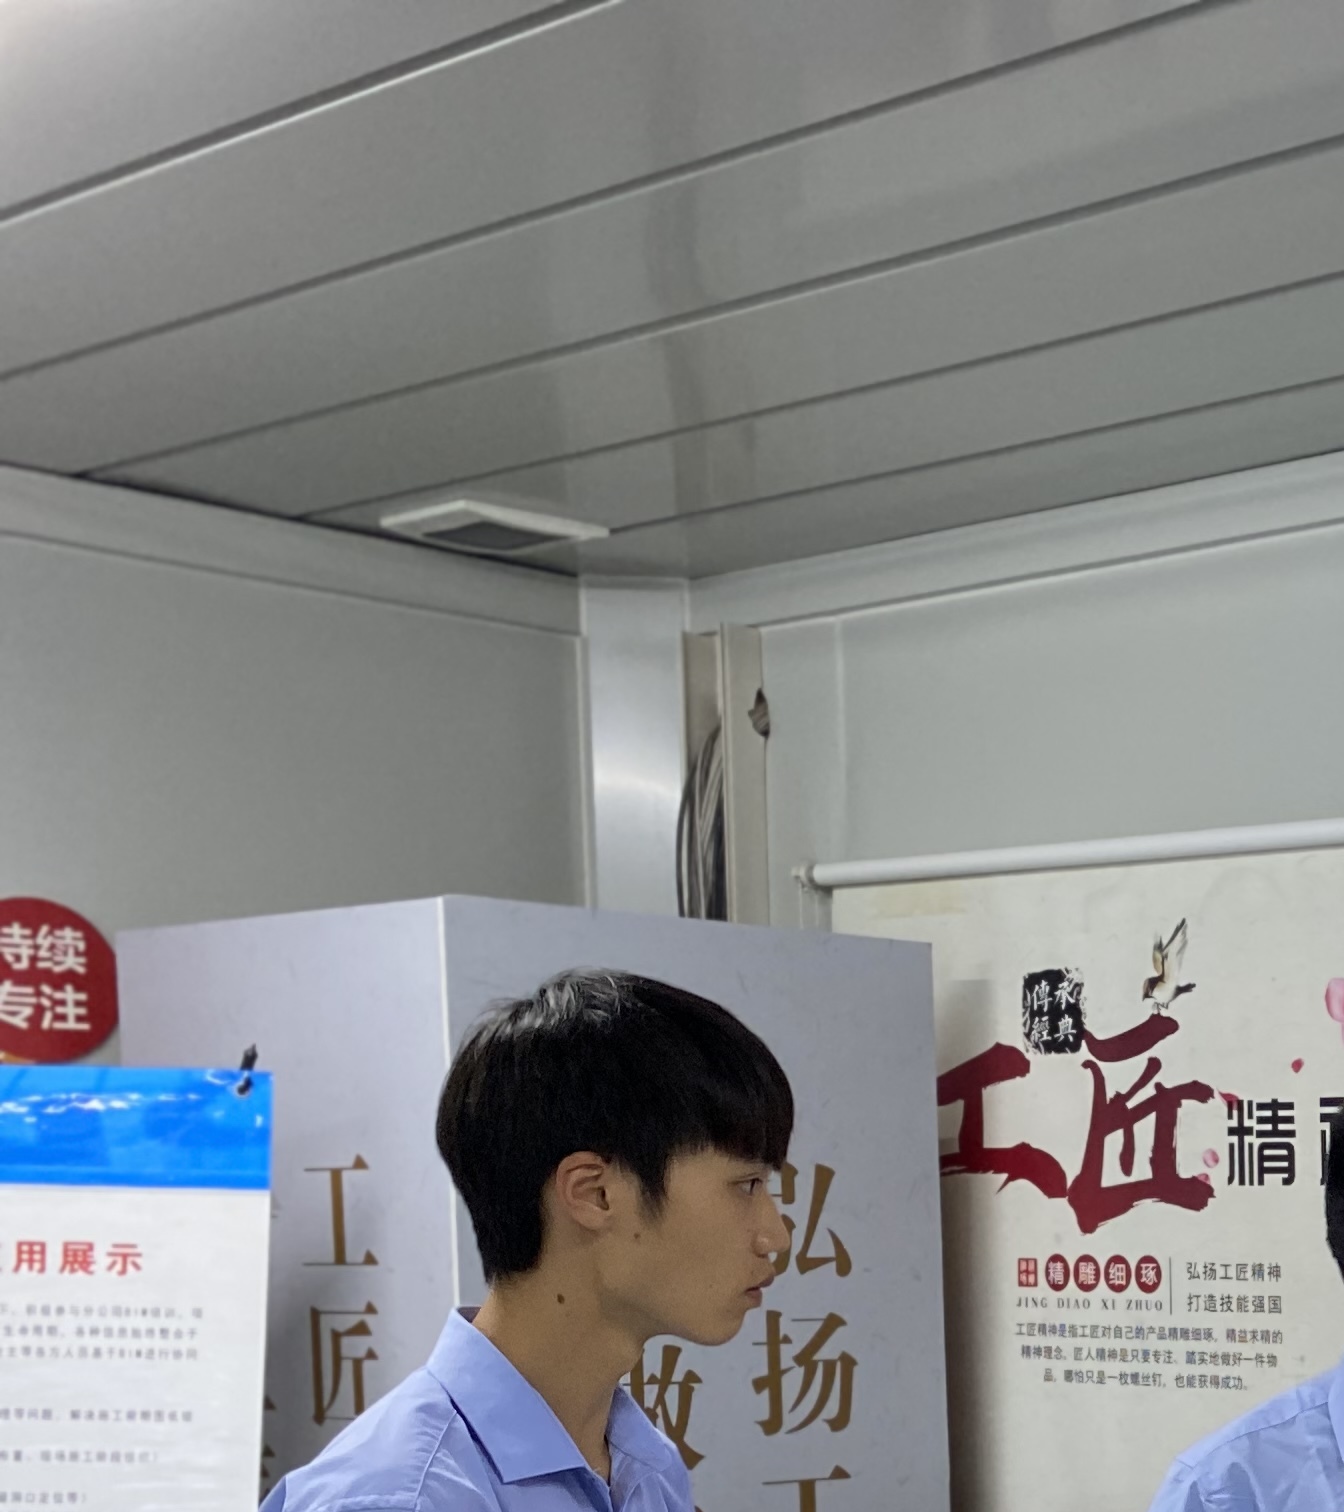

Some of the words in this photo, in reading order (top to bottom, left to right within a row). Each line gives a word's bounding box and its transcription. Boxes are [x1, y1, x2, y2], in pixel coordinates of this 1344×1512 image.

[0, 1241, 143, 1277] 用展示
[1047, 1260, 1160, 1291] 精雕细琢
[1186, 1262, 1282, 1282] 弘扬工匠精神
[1016, 1297, 1048, 1309] JING
[1057, 1297, 1091, 1310] DIAO
[1101, 1299, 1117, 1311] XI
[1126, 1299, 1163, 1312] ZHUO
[1187, 1293, 1283, 1315] 打造技能强国
